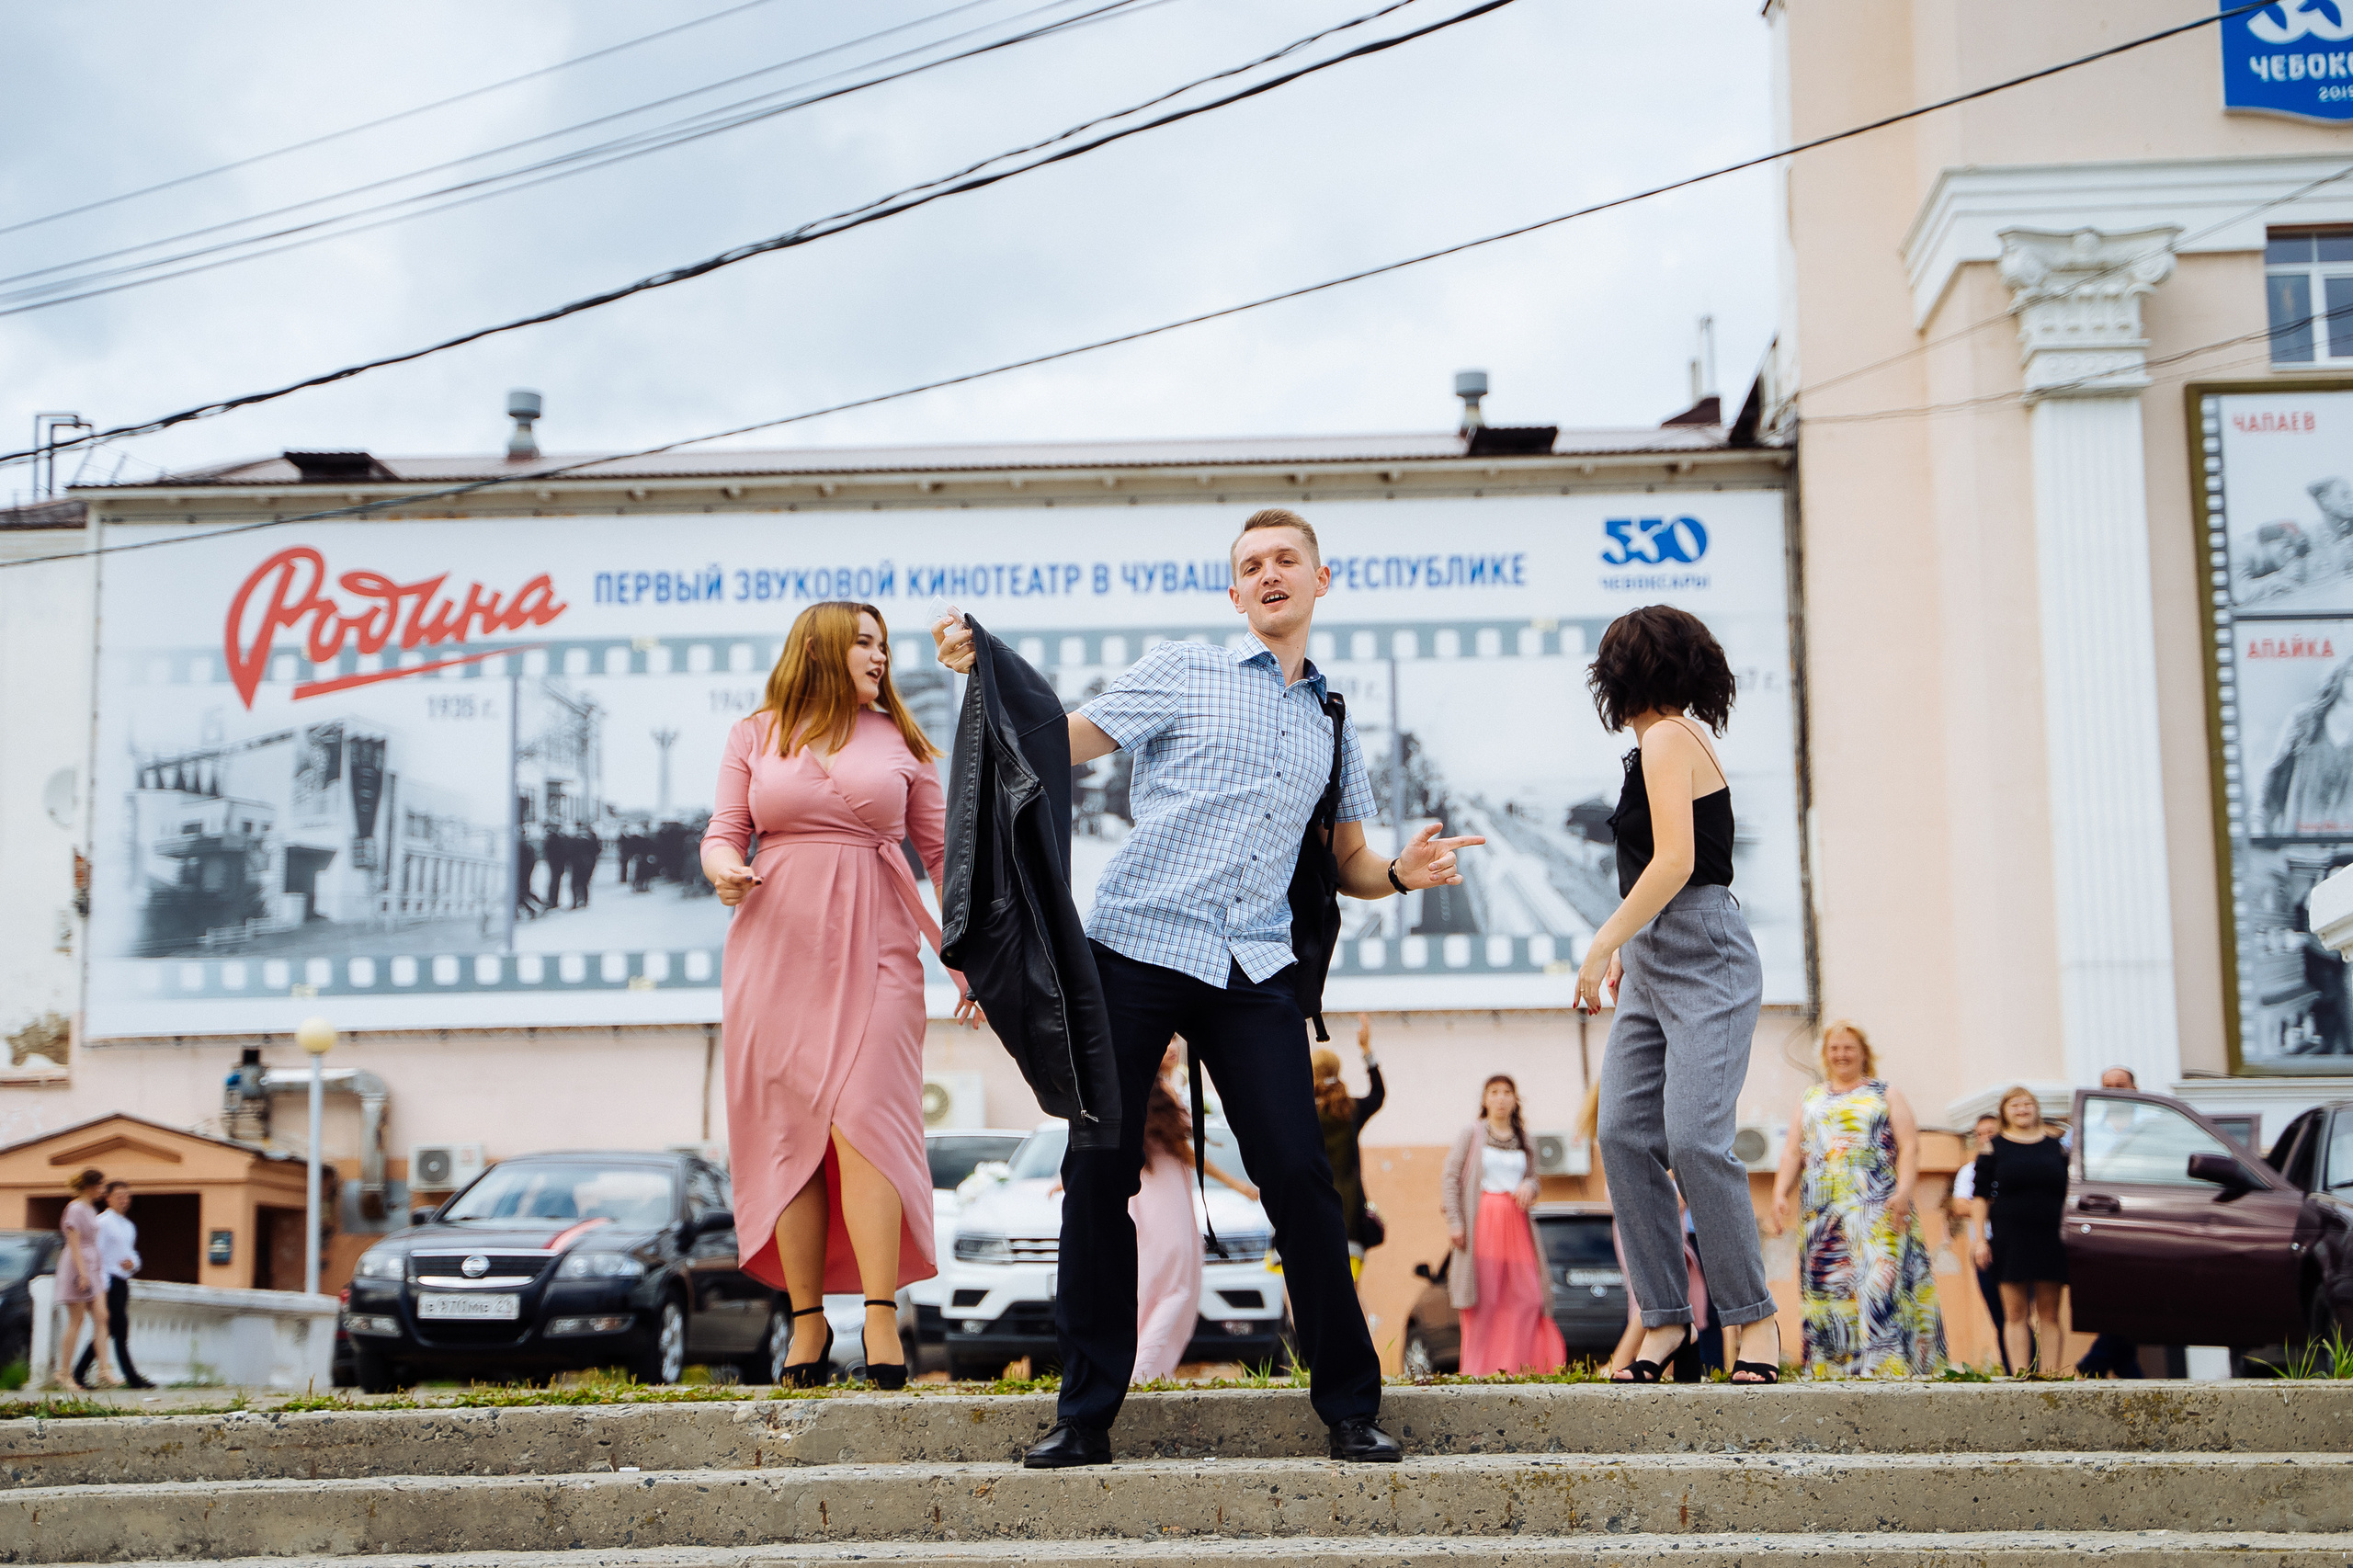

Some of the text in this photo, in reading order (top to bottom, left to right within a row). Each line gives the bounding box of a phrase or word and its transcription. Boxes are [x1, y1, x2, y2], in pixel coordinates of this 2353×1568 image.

[2249, 51, 2353, 82] ЧЕБОК
[2234, 413, 2315, 432] ЧАПАЕВ
[1603, 518, 1707, 564] 550
[596, 554, 1525, 604] ПЕРВЫЙ ЗВУКОВОЙ КИНОТЕАТР В ЧУВАШ РЕСПУБЛИКЕ
[226, 546, 568, 710] Родина
[2247, 634, 2335, 659] АПАЙКА
